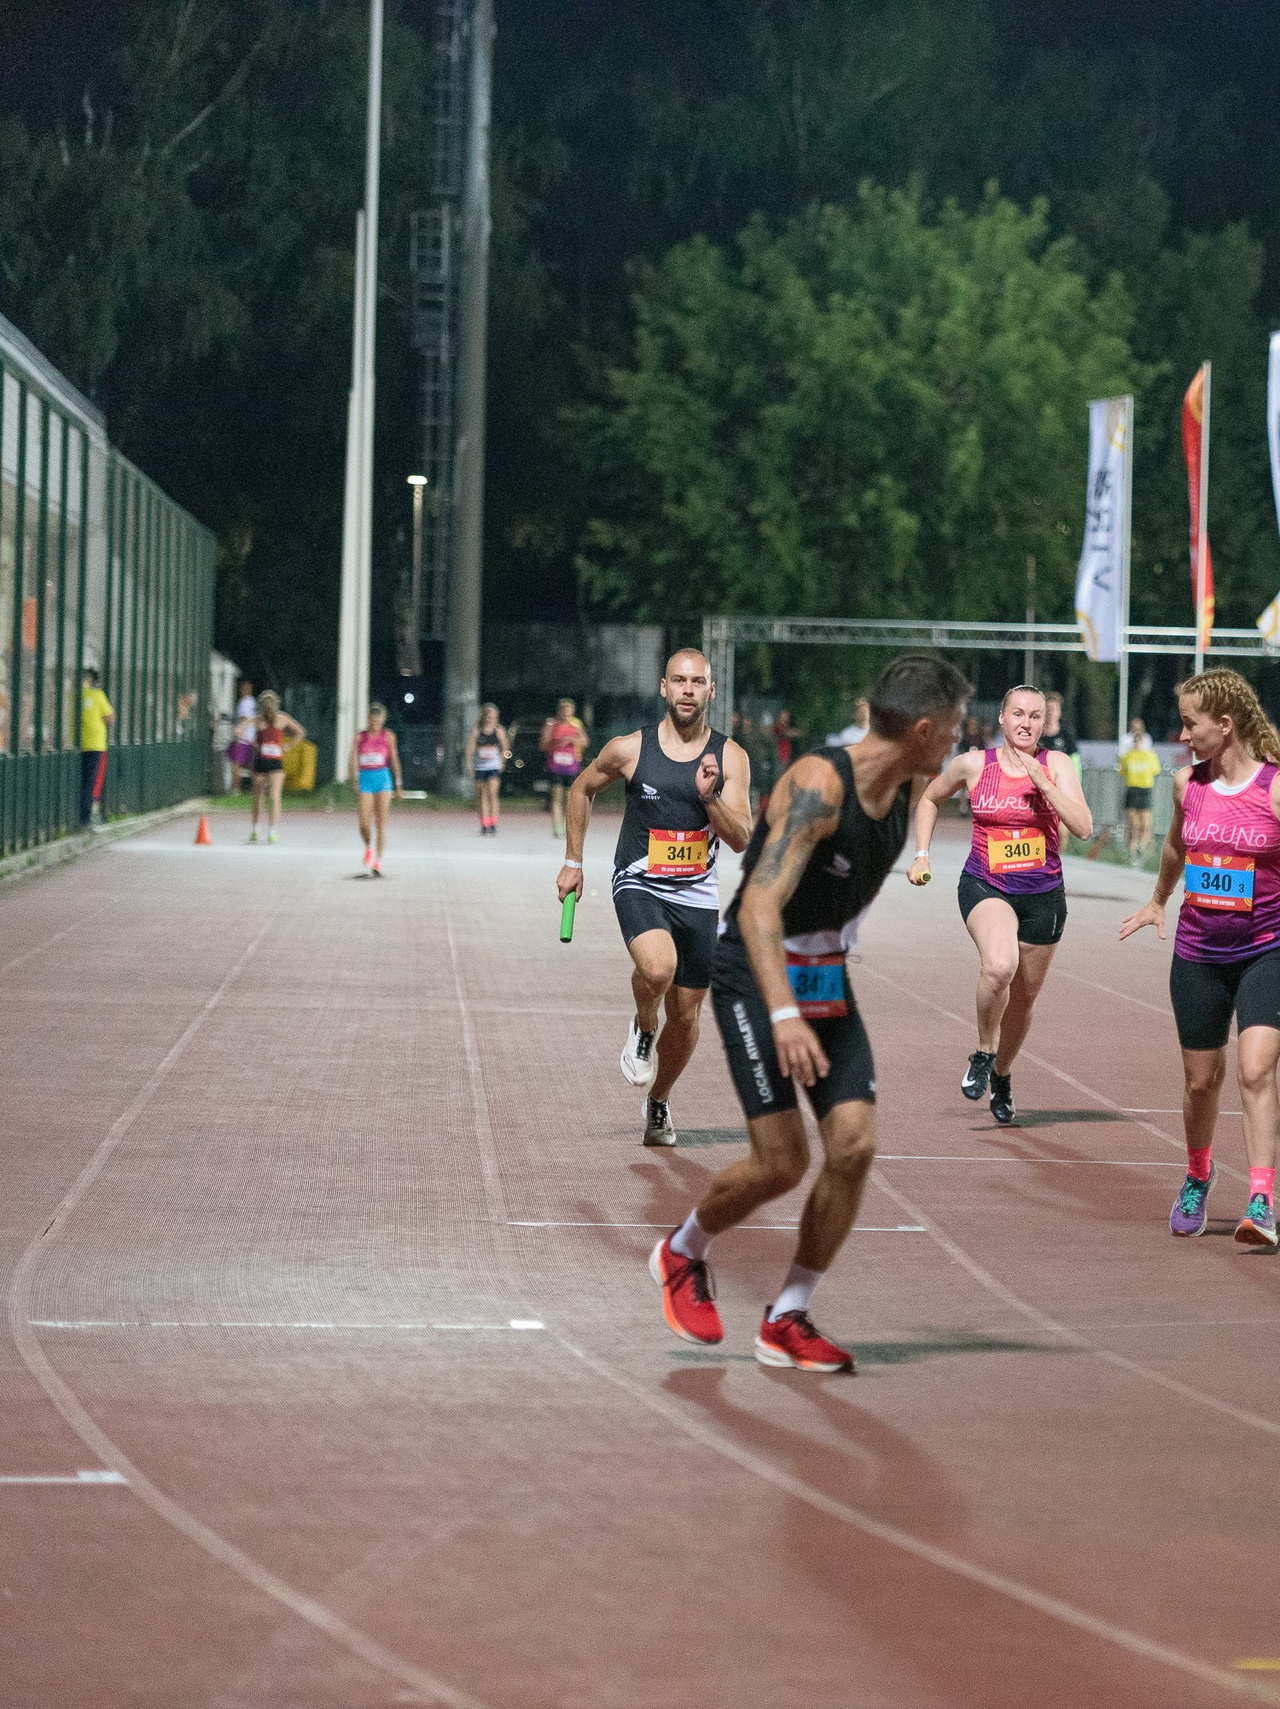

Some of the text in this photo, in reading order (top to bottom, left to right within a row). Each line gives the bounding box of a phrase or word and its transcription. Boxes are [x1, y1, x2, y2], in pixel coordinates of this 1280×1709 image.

[667, 846, 702, 861] 341 2
[1004, 843, 1041, 858] 340 2
[1201, 872, 1245, 893] 340 3
[733, 1003, 774, 1104] LOCAL ATHLETES
